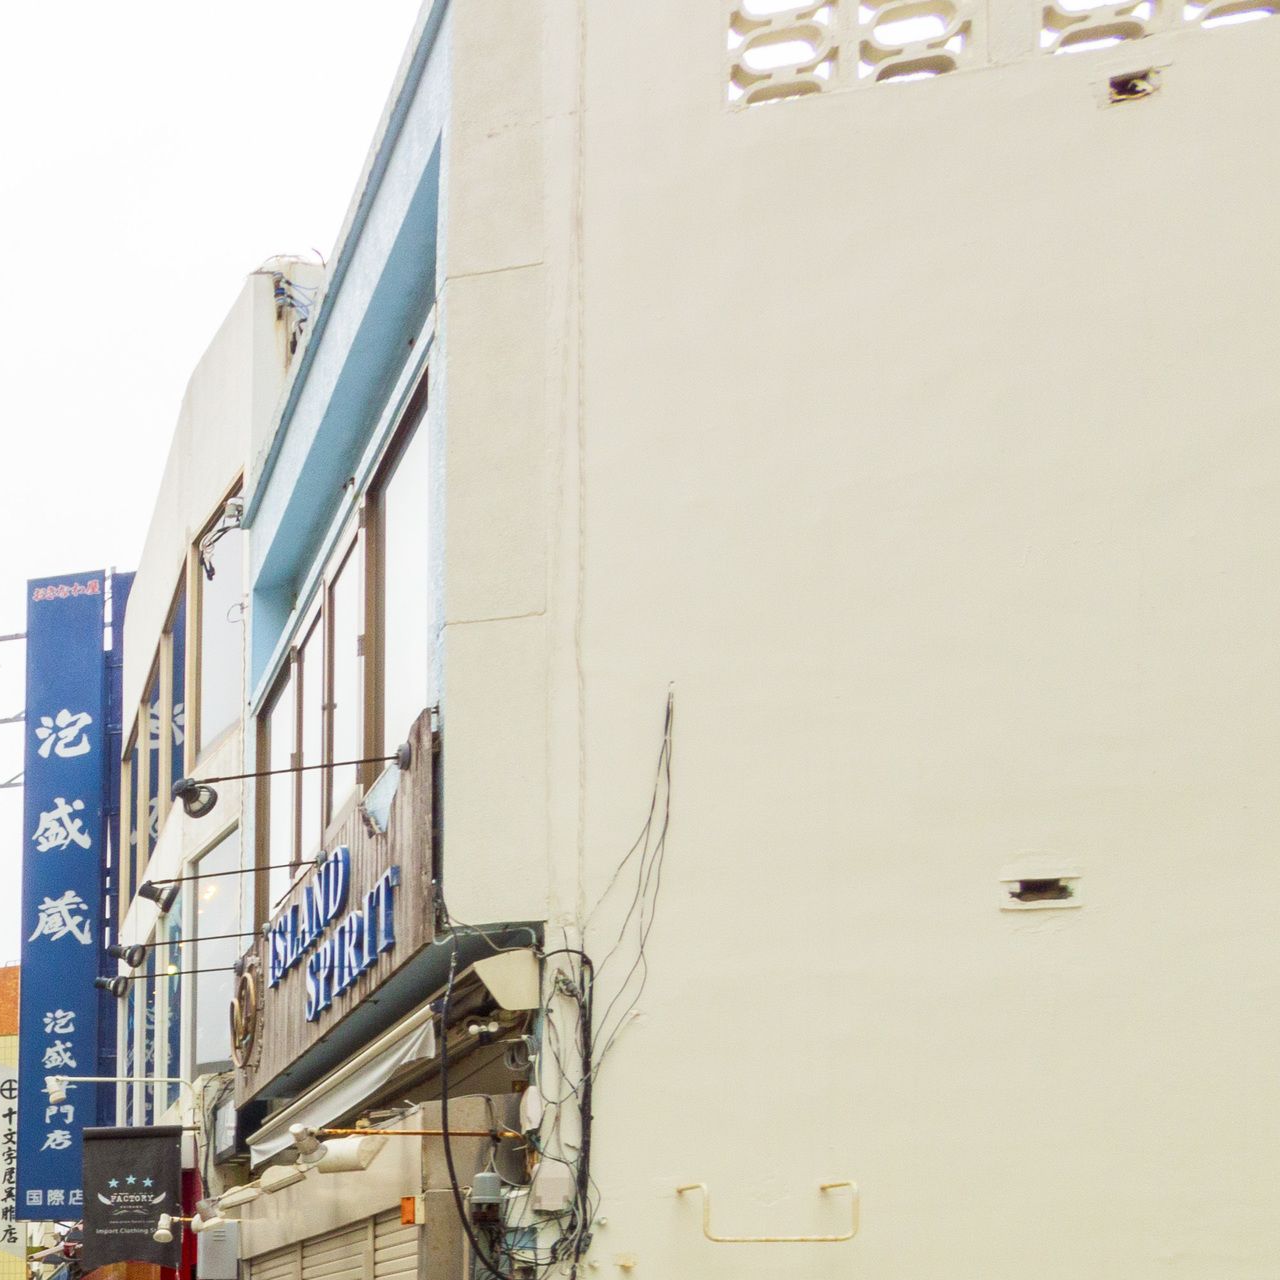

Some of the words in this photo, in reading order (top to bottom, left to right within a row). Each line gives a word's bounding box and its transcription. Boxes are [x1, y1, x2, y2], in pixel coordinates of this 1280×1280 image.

[266, 844, 351, 989] ISLAND
[304, 866, 400, 1023] SPIRIT
[26, 1189, 83, 1206] 国際店
[110, 1194, 155, 1203] FACTORY
[120, 1226, 149, 1235] Clothing
